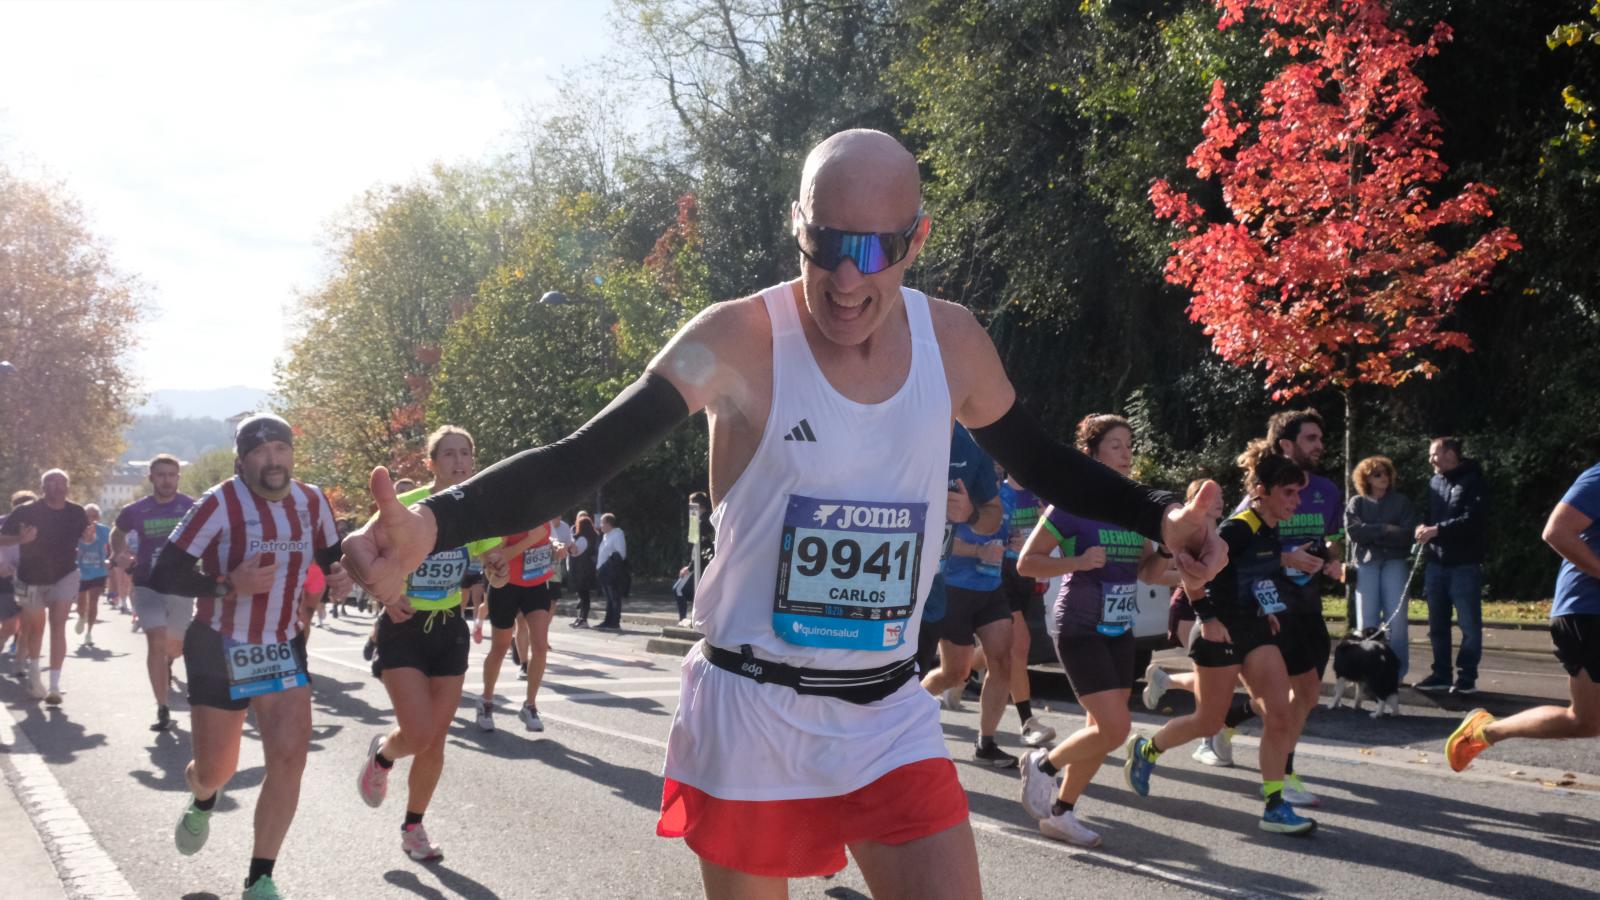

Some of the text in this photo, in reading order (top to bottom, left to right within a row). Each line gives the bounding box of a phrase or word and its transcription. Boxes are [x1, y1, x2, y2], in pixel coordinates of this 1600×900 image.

[250, 540, 309, 551] Petronor
[783, 533, 791, 551] 8
[797, 536, 911, 582] 9941
[416, 562, 464, 578] 8591
[829, 587, 886, 603] CARLOS
[233, 643, 291, 668] 6866
